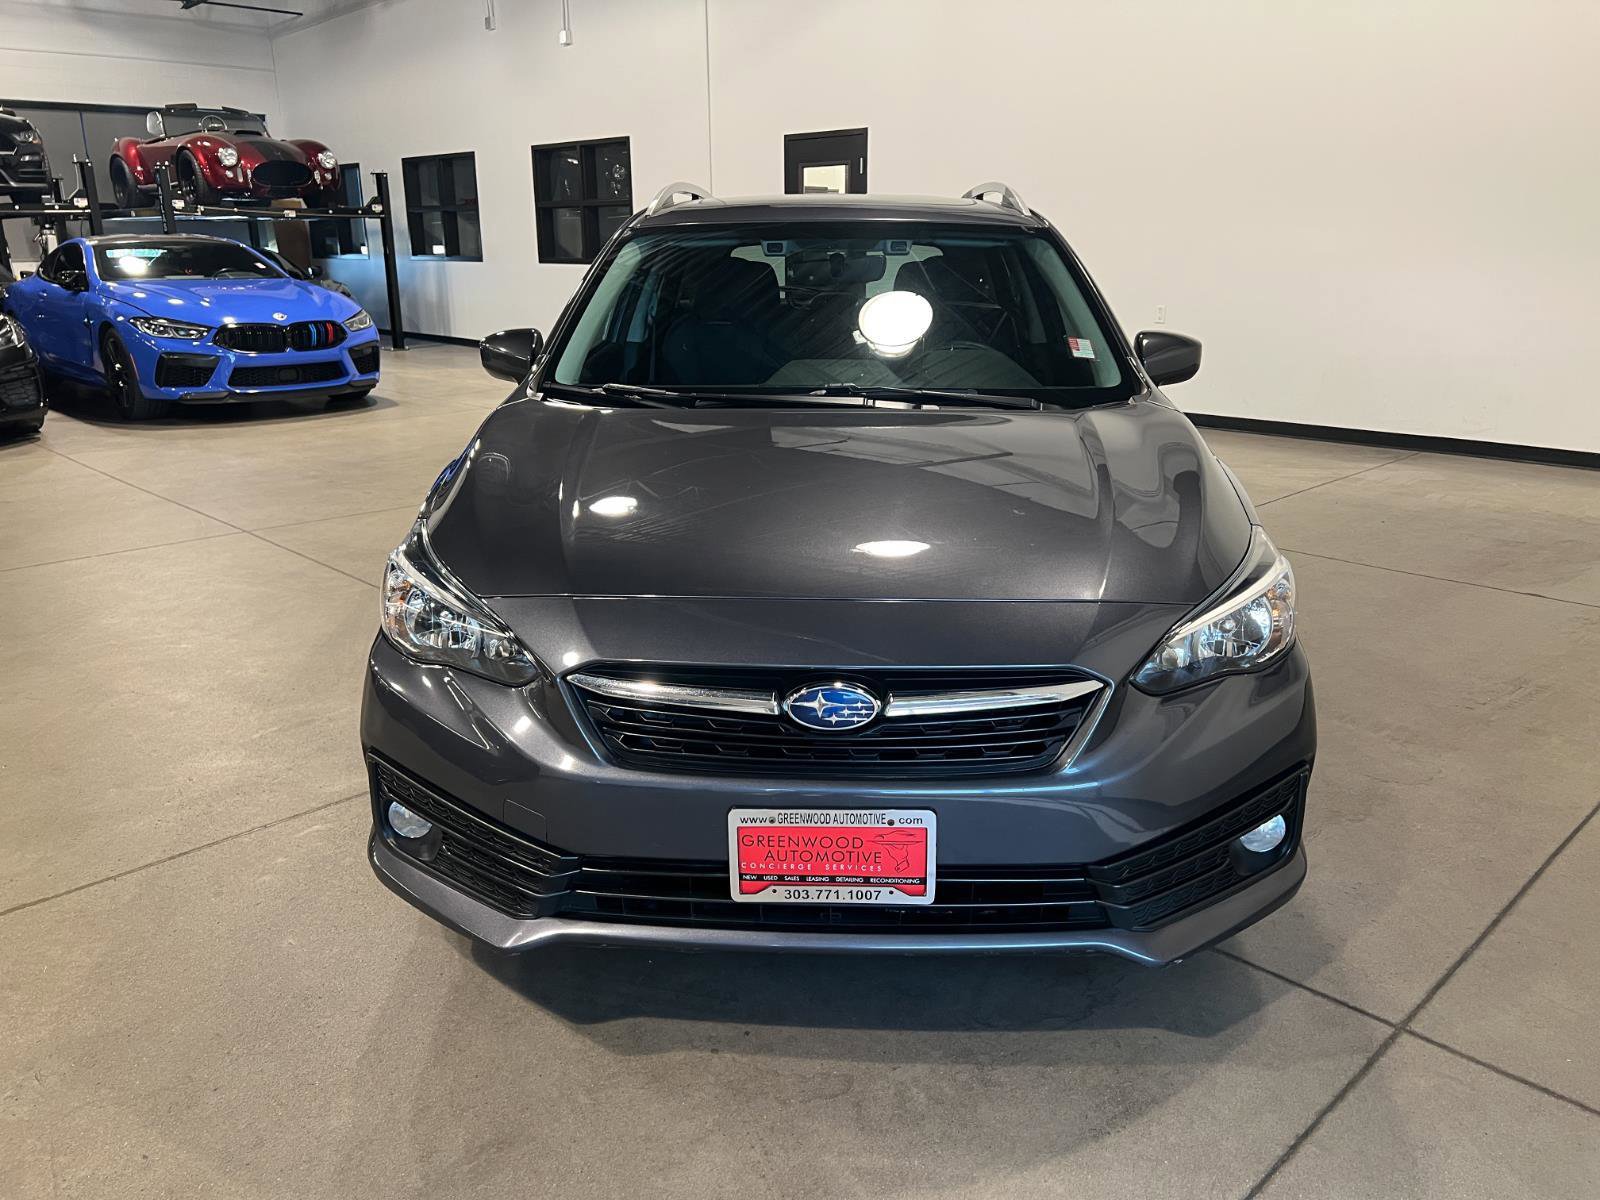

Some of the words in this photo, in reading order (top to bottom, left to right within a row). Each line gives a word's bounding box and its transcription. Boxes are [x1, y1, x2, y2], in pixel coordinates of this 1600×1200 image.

[777, 813, 830, 824] GREENWOOD
[833, 813, 886, 825] AUTOMOTIVE
[742, 835, 863, 849] GREENWOOD
[764, 851, 882, 864] AUTOMOTIVE
[785, 890, 881, 900] 303.771.1007
